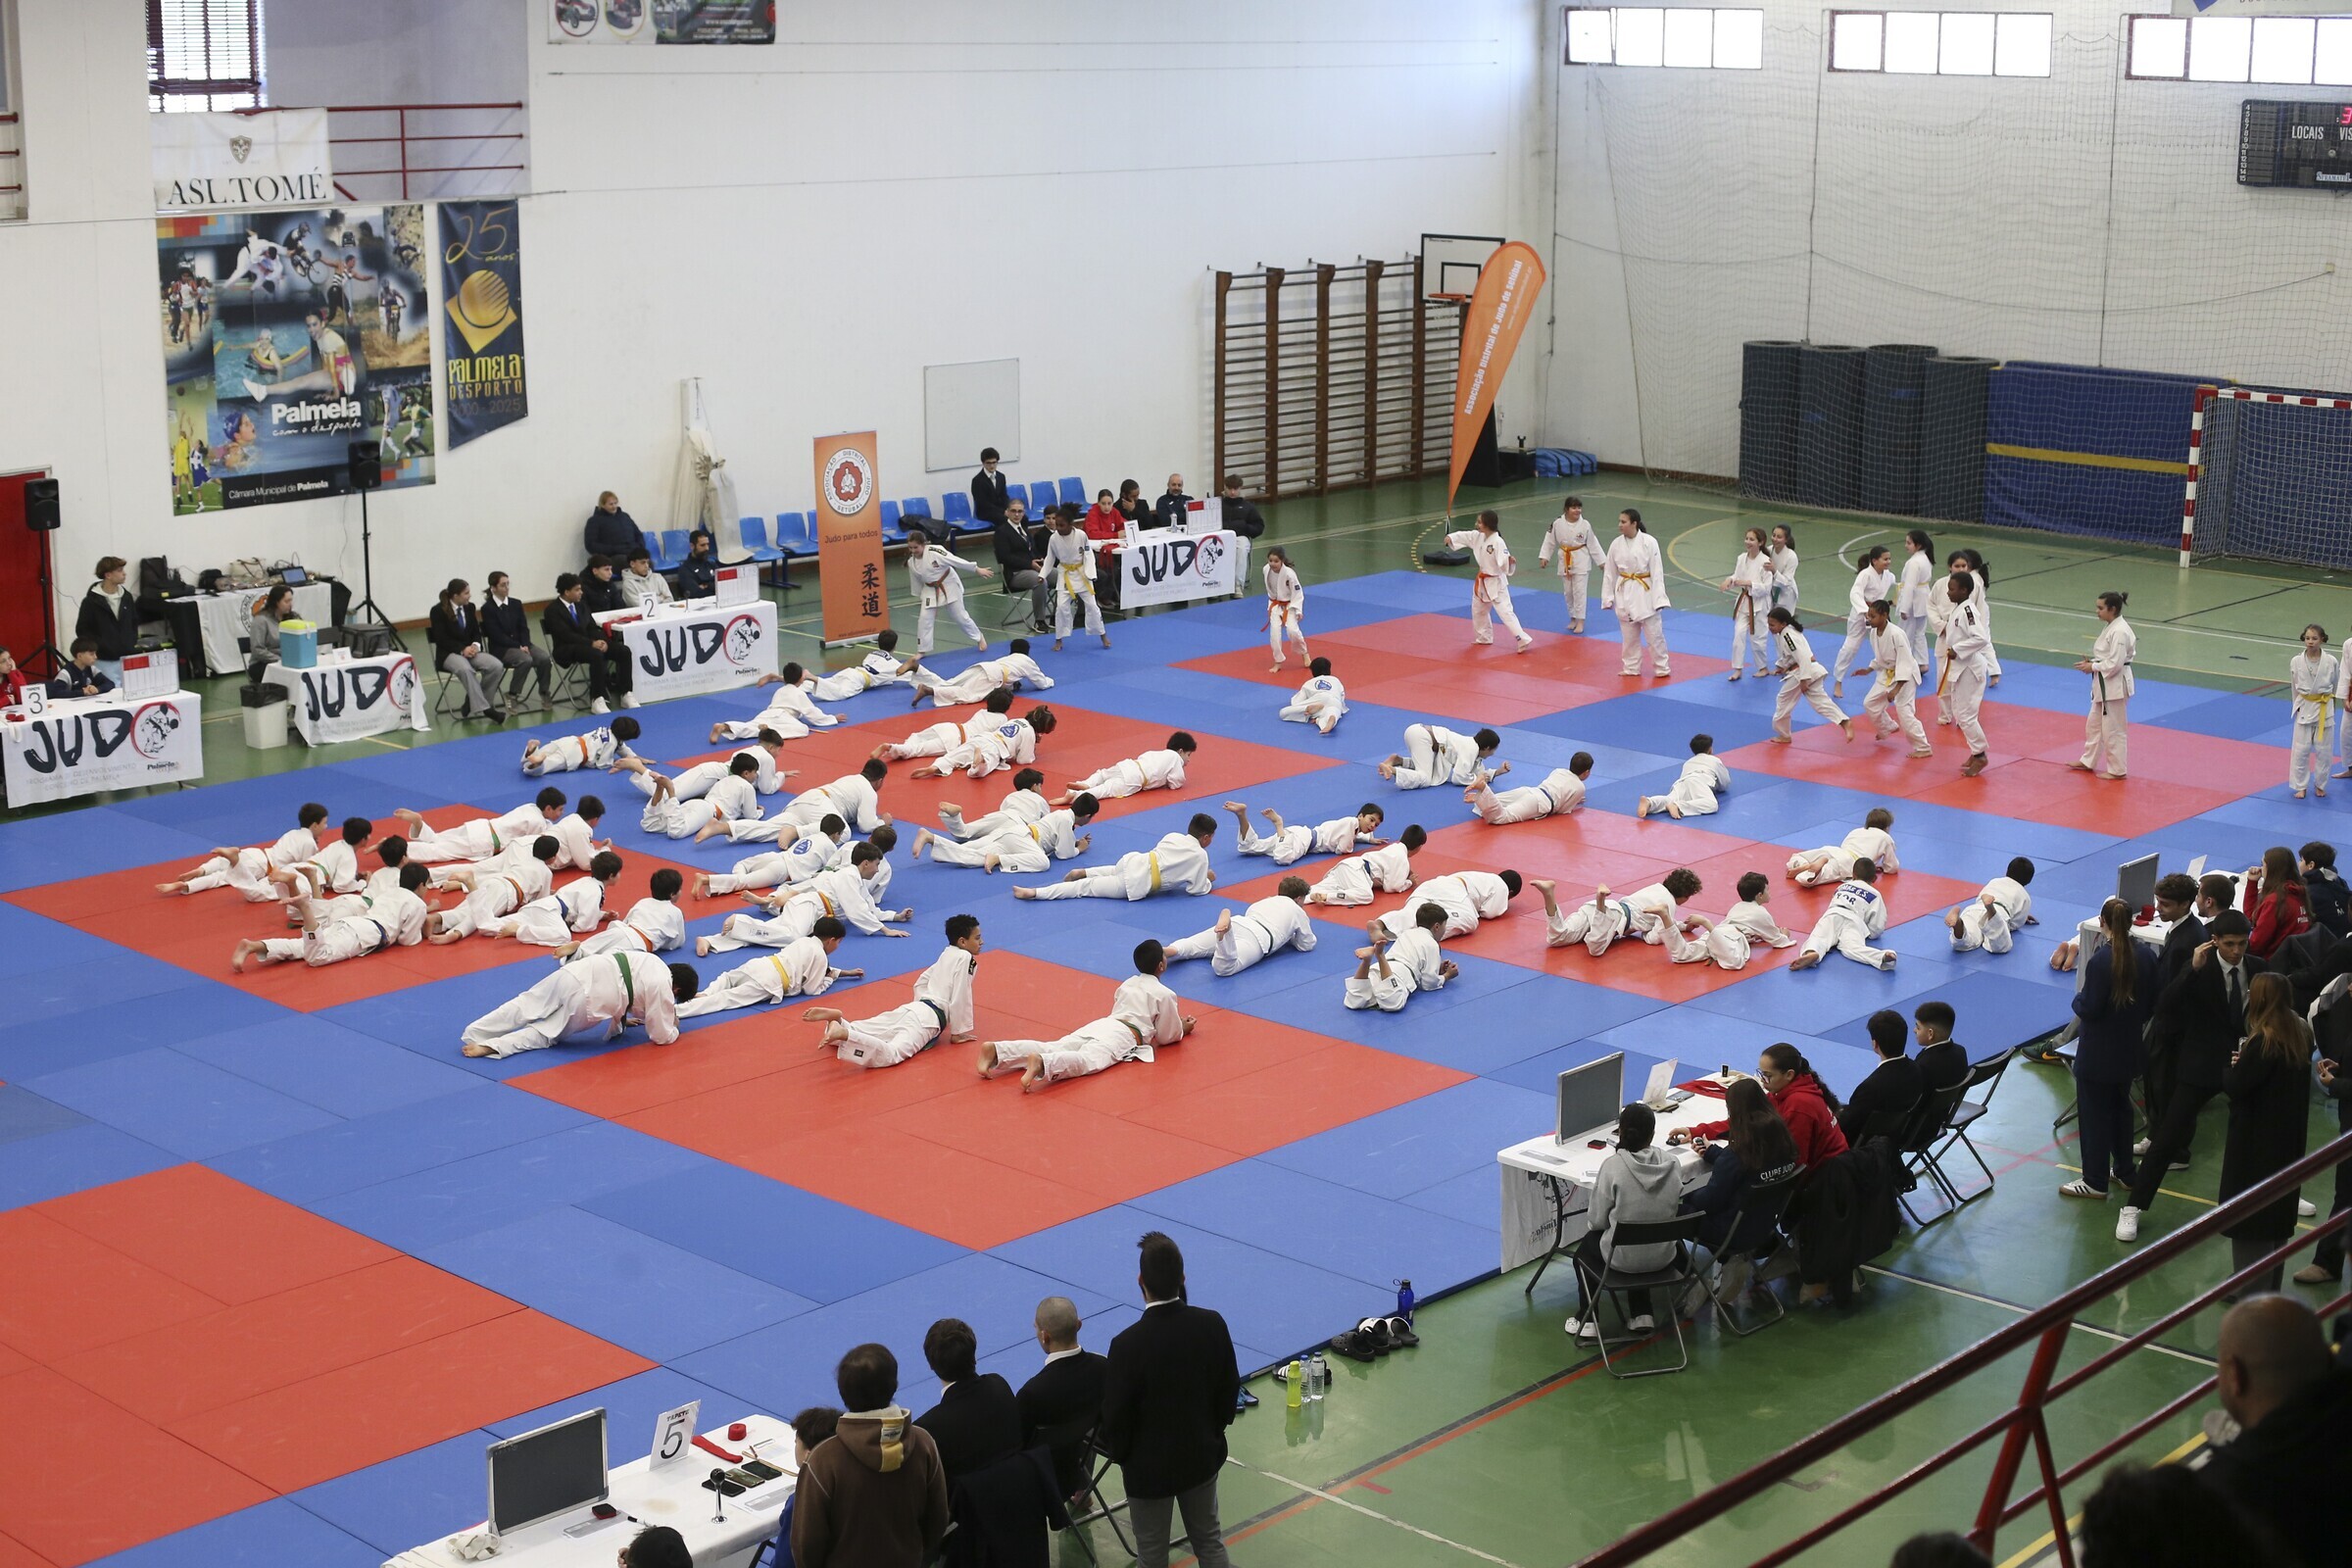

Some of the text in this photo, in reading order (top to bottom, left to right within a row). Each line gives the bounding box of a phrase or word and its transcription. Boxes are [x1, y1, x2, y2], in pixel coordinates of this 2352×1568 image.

[2291, 125, 2325, 139] LOCAIS
[445, 206, 515, 264] 25
[485, 253, 515, 263] anos
[449, 379, 522, 400] DESPORTO
[271, 397, 362, 425] Palmela
[311, 418, 362, 437] desporto
[843, 450, 866, 467] DISTRITAL
[228, 479, 329, 500] Câmara Municipal de Palmela
[824, 529, 878, 544] Judo para todos
[860, 563, 882, 618] 柔道
[644, 598, 656, 618] 2
[28, 692, 43, 714] 3
[666, 1409, 690, 1422] TAPETE
[661, 1418, 686, 1460] 5
